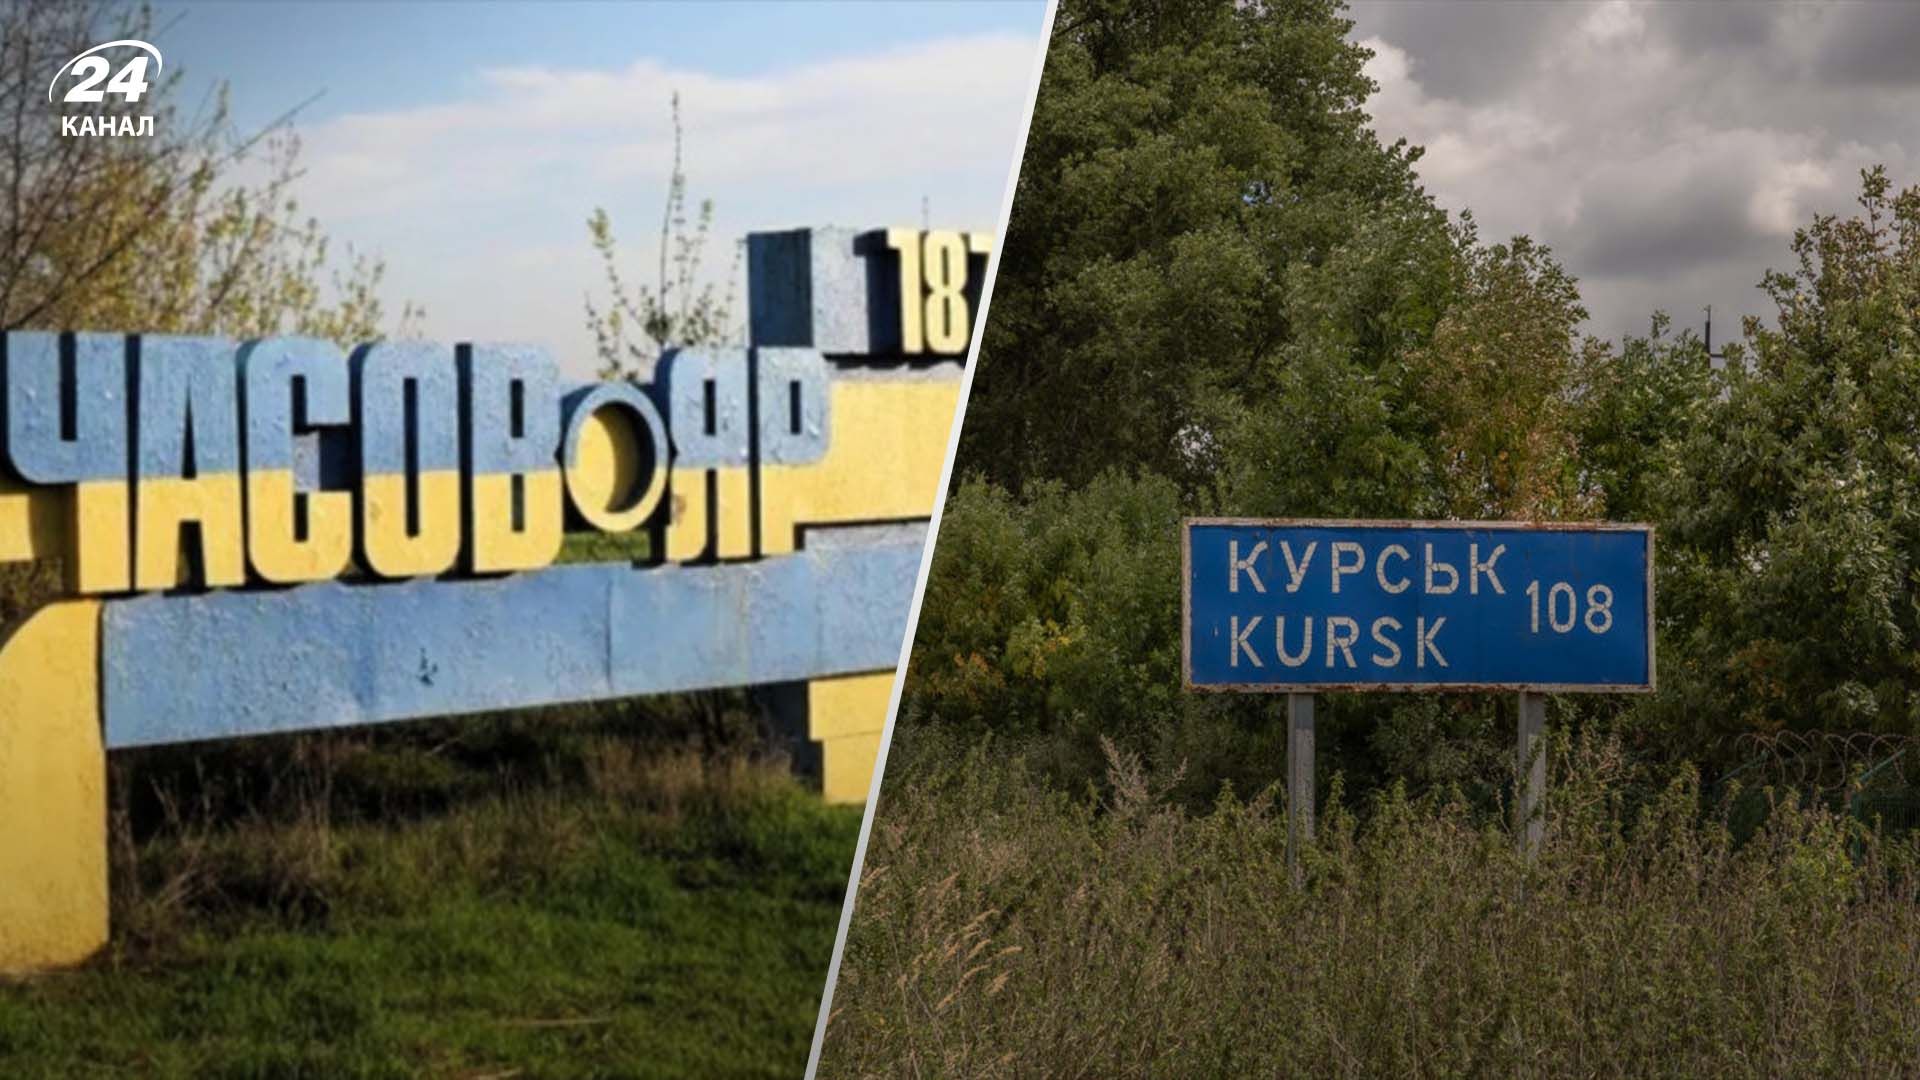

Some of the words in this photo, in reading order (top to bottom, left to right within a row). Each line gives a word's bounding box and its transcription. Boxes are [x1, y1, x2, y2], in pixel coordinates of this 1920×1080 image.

[6, 331, 564, 593] ЧАСОВ
[665, 346, 832, 561] ЯР
[1228, 539, 1507, 596] КУРСЬК
[1525, 579, 1614, 635] 108
[1229, 615, 1449, 669] KURSK
